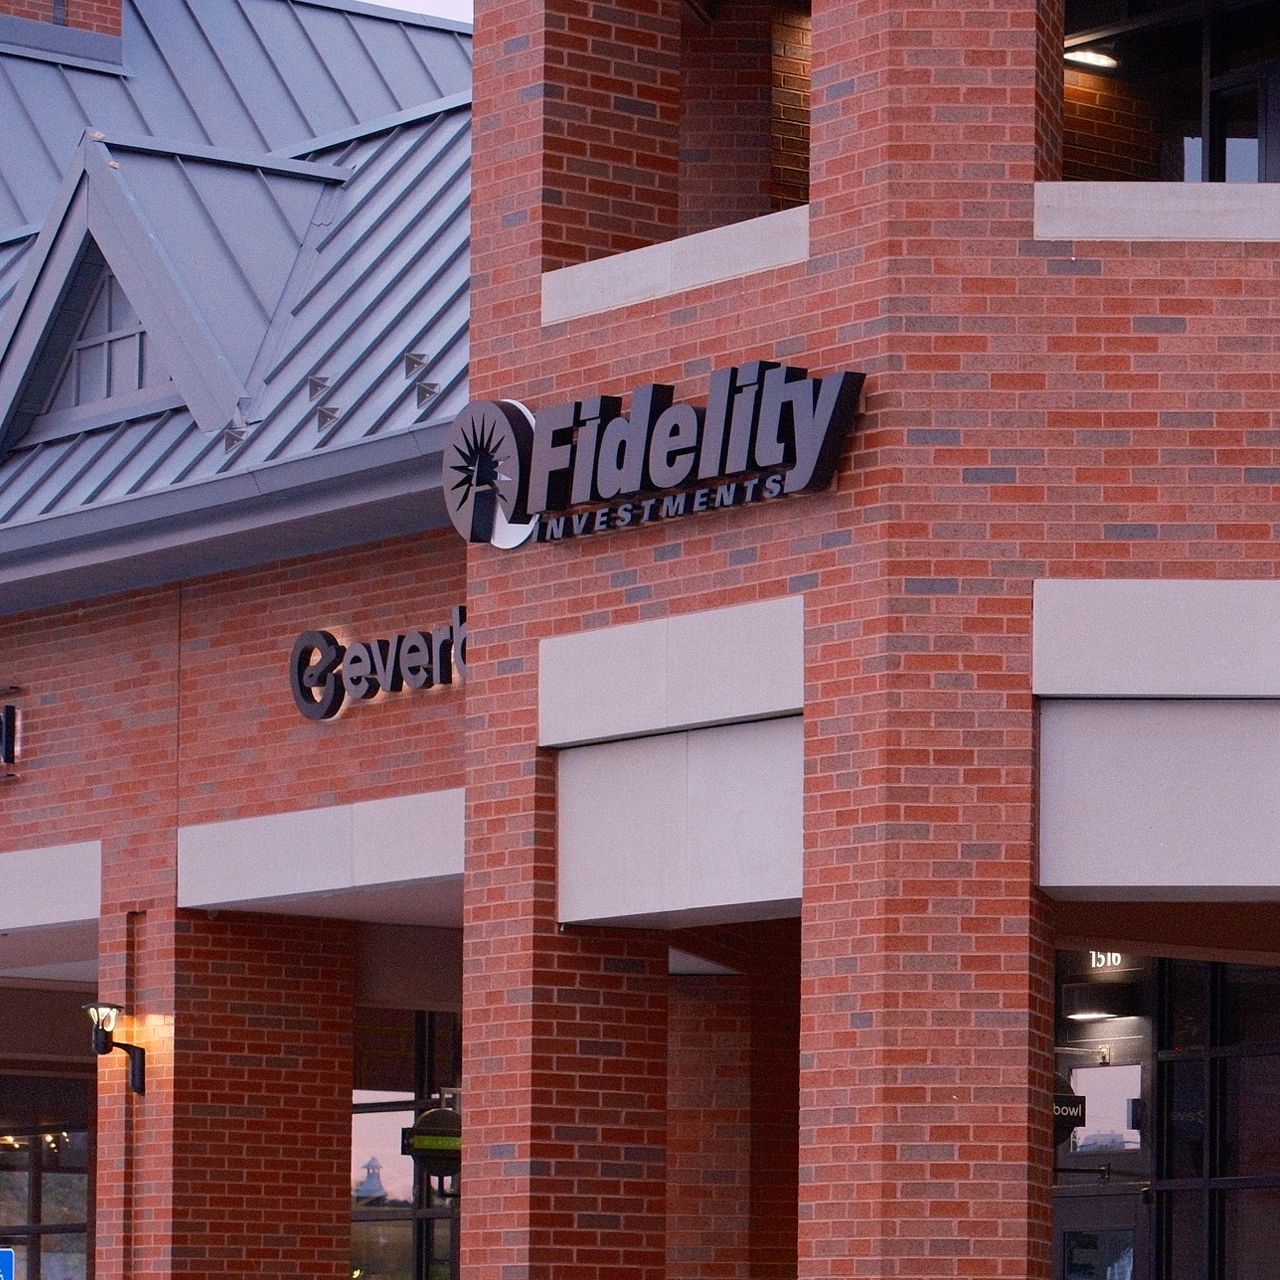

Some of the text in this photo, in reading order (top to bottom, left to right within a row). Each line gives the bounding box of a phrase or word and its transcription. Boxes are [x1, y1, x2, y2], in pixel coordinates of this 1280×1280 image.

[529, 361, 862, 514] Fidelity
[532, 474, 785, 543] INVESTMENTS
[1053, 1102, 1082, 1117] bowl
